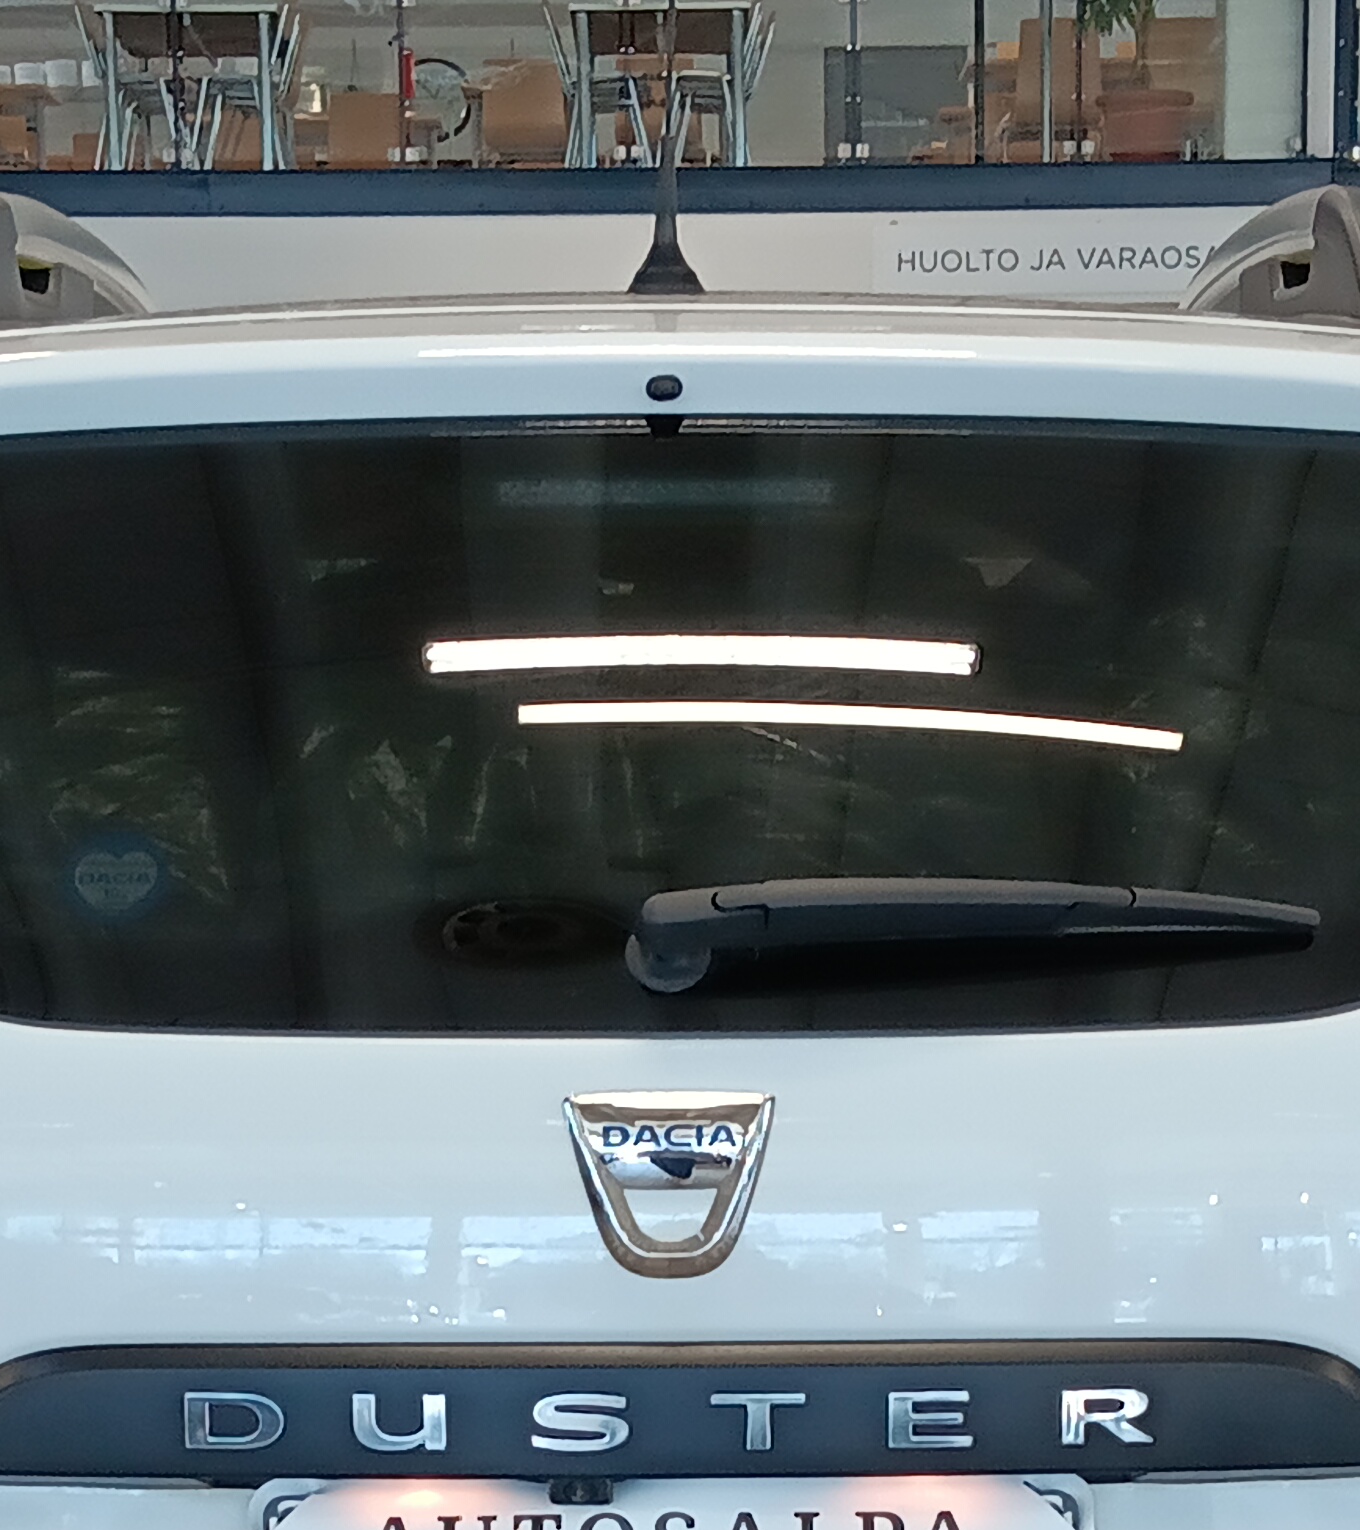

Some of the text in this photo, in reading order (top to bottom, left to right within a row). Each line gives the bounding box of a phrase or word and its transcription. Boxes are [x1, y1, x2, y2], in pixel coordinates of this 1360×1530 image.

[896, 247, 1020, 273] HUOLTO
[1029, 246, 1067, 272] JA
[601, 1124, 737, 1148] DACIA
[182, 1386, 1156, 1453] DUSTER
